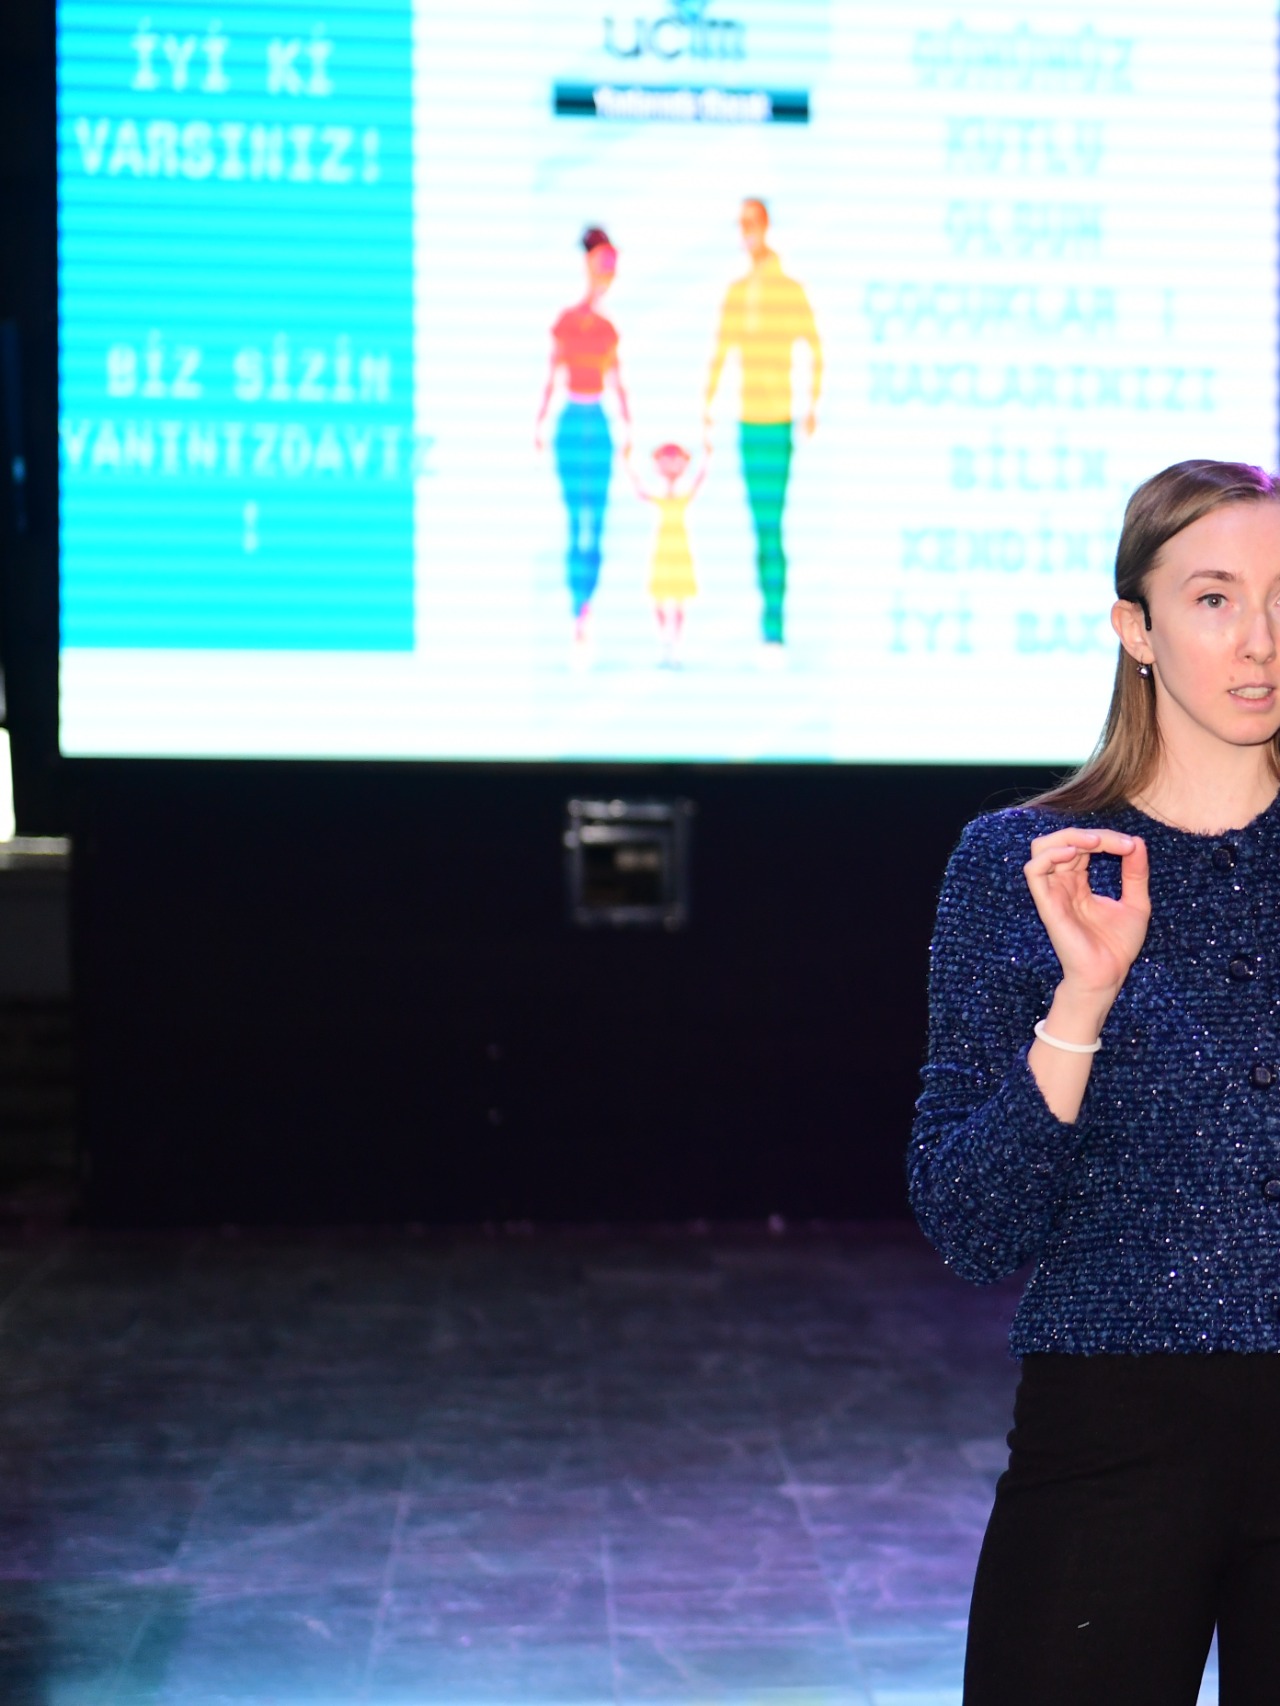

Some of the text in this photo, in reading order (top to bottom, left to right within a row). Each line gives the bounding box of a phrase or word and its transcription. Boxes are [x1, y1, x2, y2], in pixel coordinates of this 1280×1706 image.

[130, 16, 336, 96] İYİ Kİ
[73, 116, 382, 184] VARSINIZ!
[105, 328, 204, 400] BİZ
